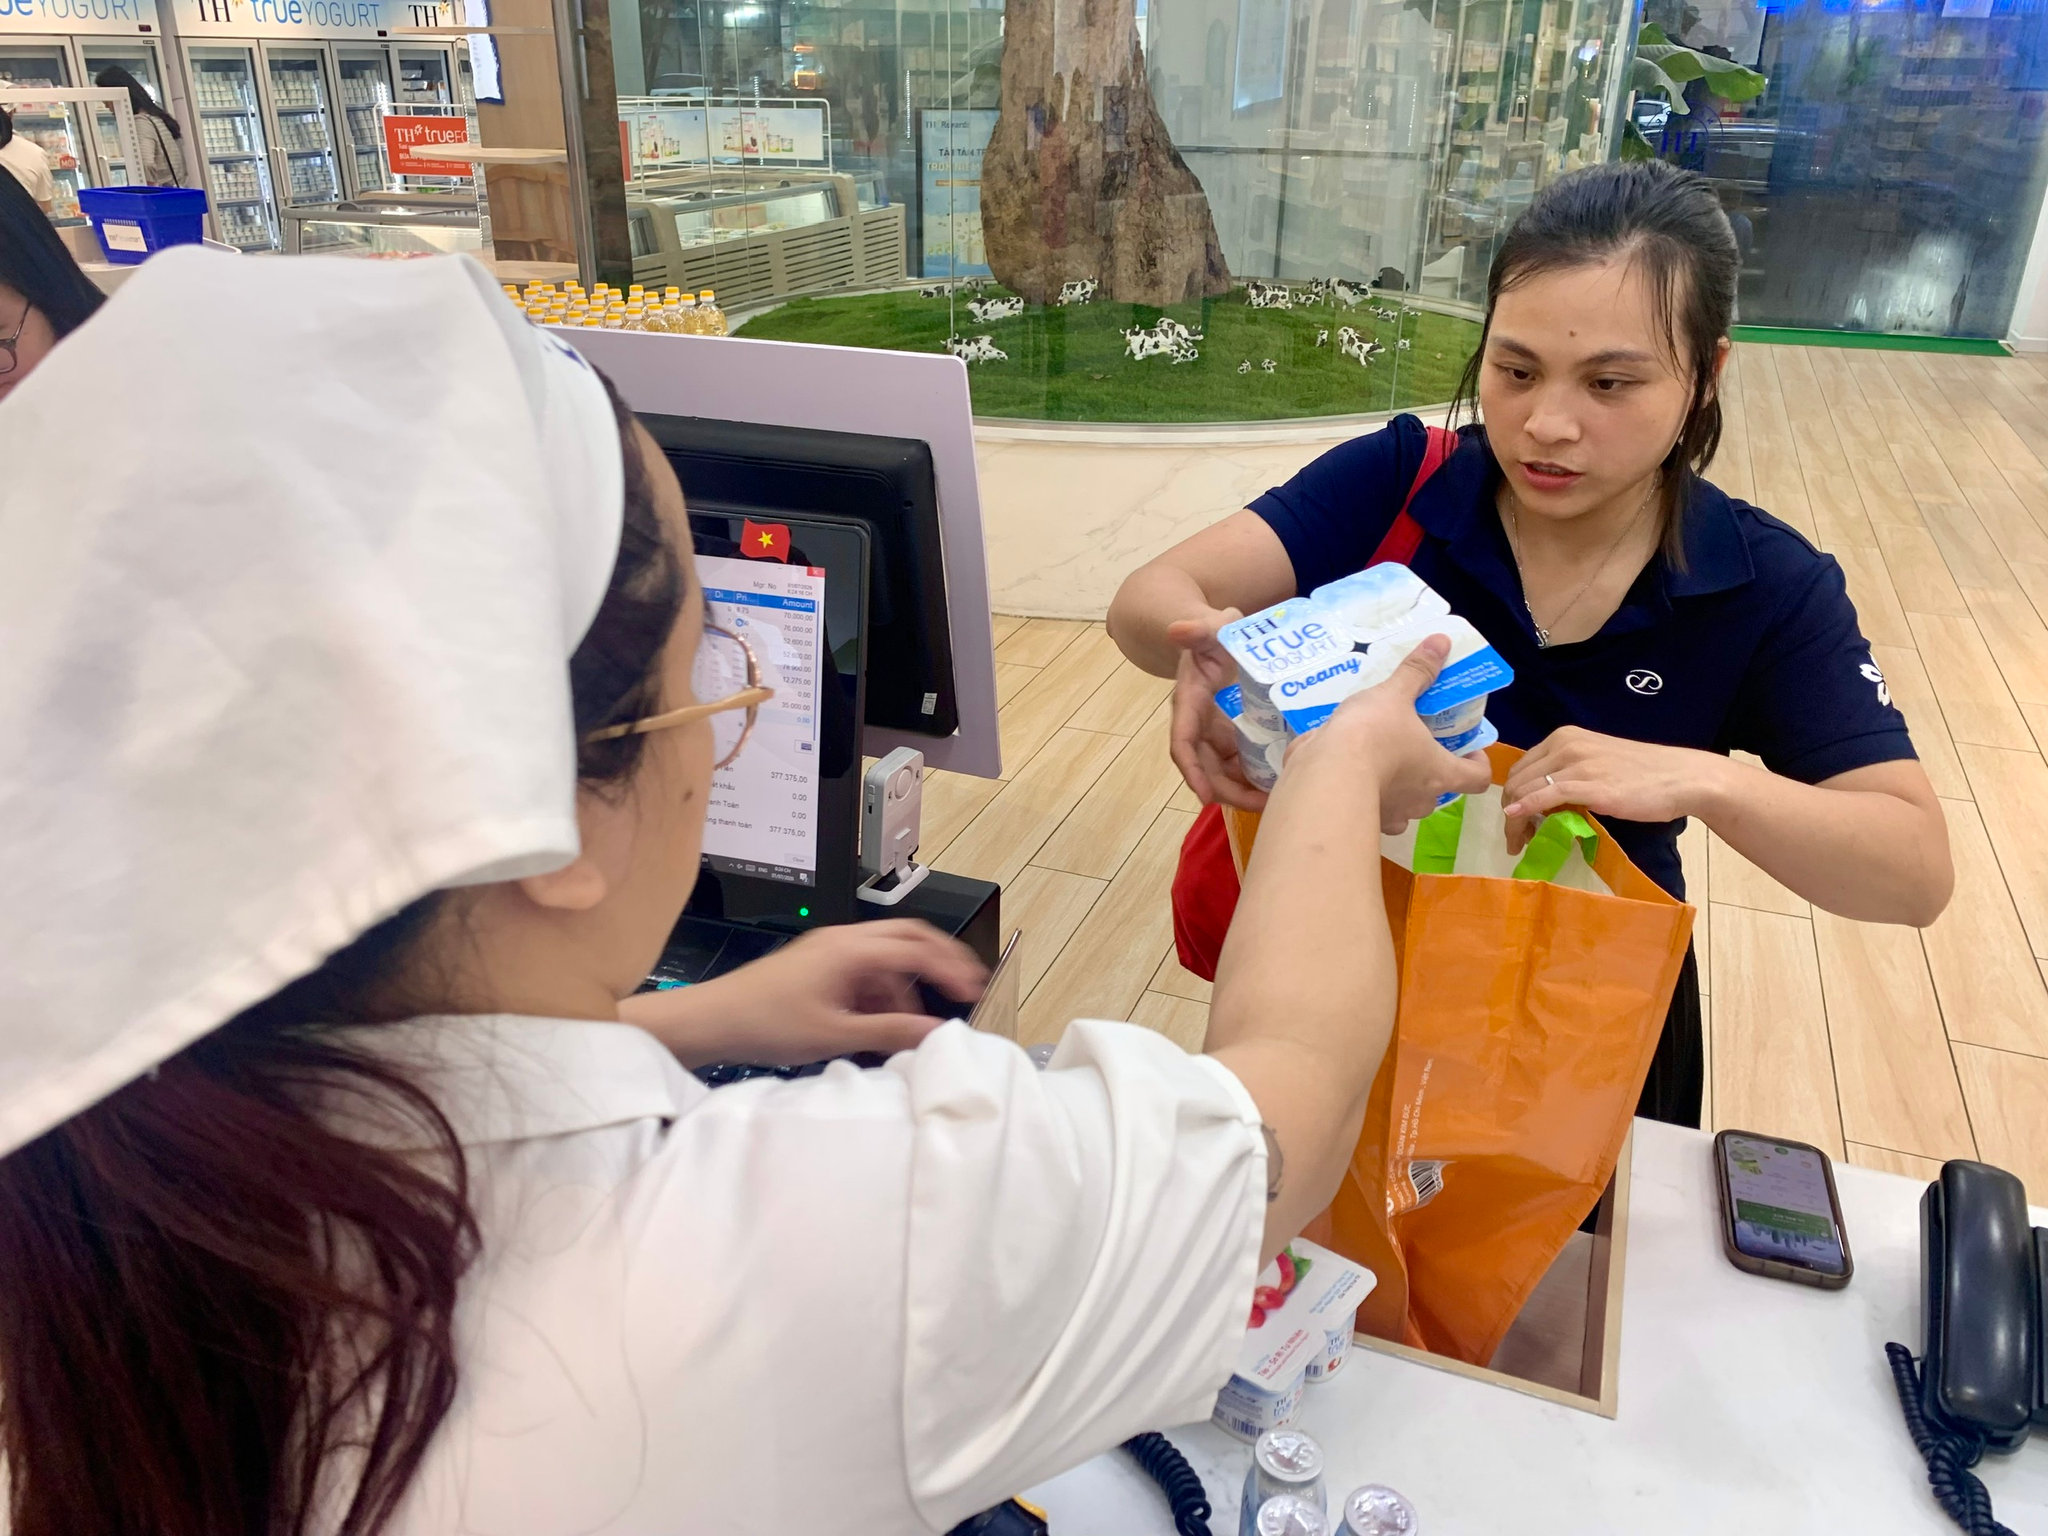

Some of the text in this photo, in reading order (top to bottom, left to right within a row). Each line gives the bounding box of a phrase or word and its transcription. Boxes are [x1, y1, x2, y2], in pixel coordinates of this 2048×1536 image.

[408, 5, 438, 27] TH
[394, 128, 415, 142] TH
[782, 599, 813, 609] Amount
[1232, 618, 1278, 640] TH
[1245, 623, 1327, 662] true
[1261, 635, 1338, 674] YOGURT
[1281, 658, 1362, 697] Creamy
